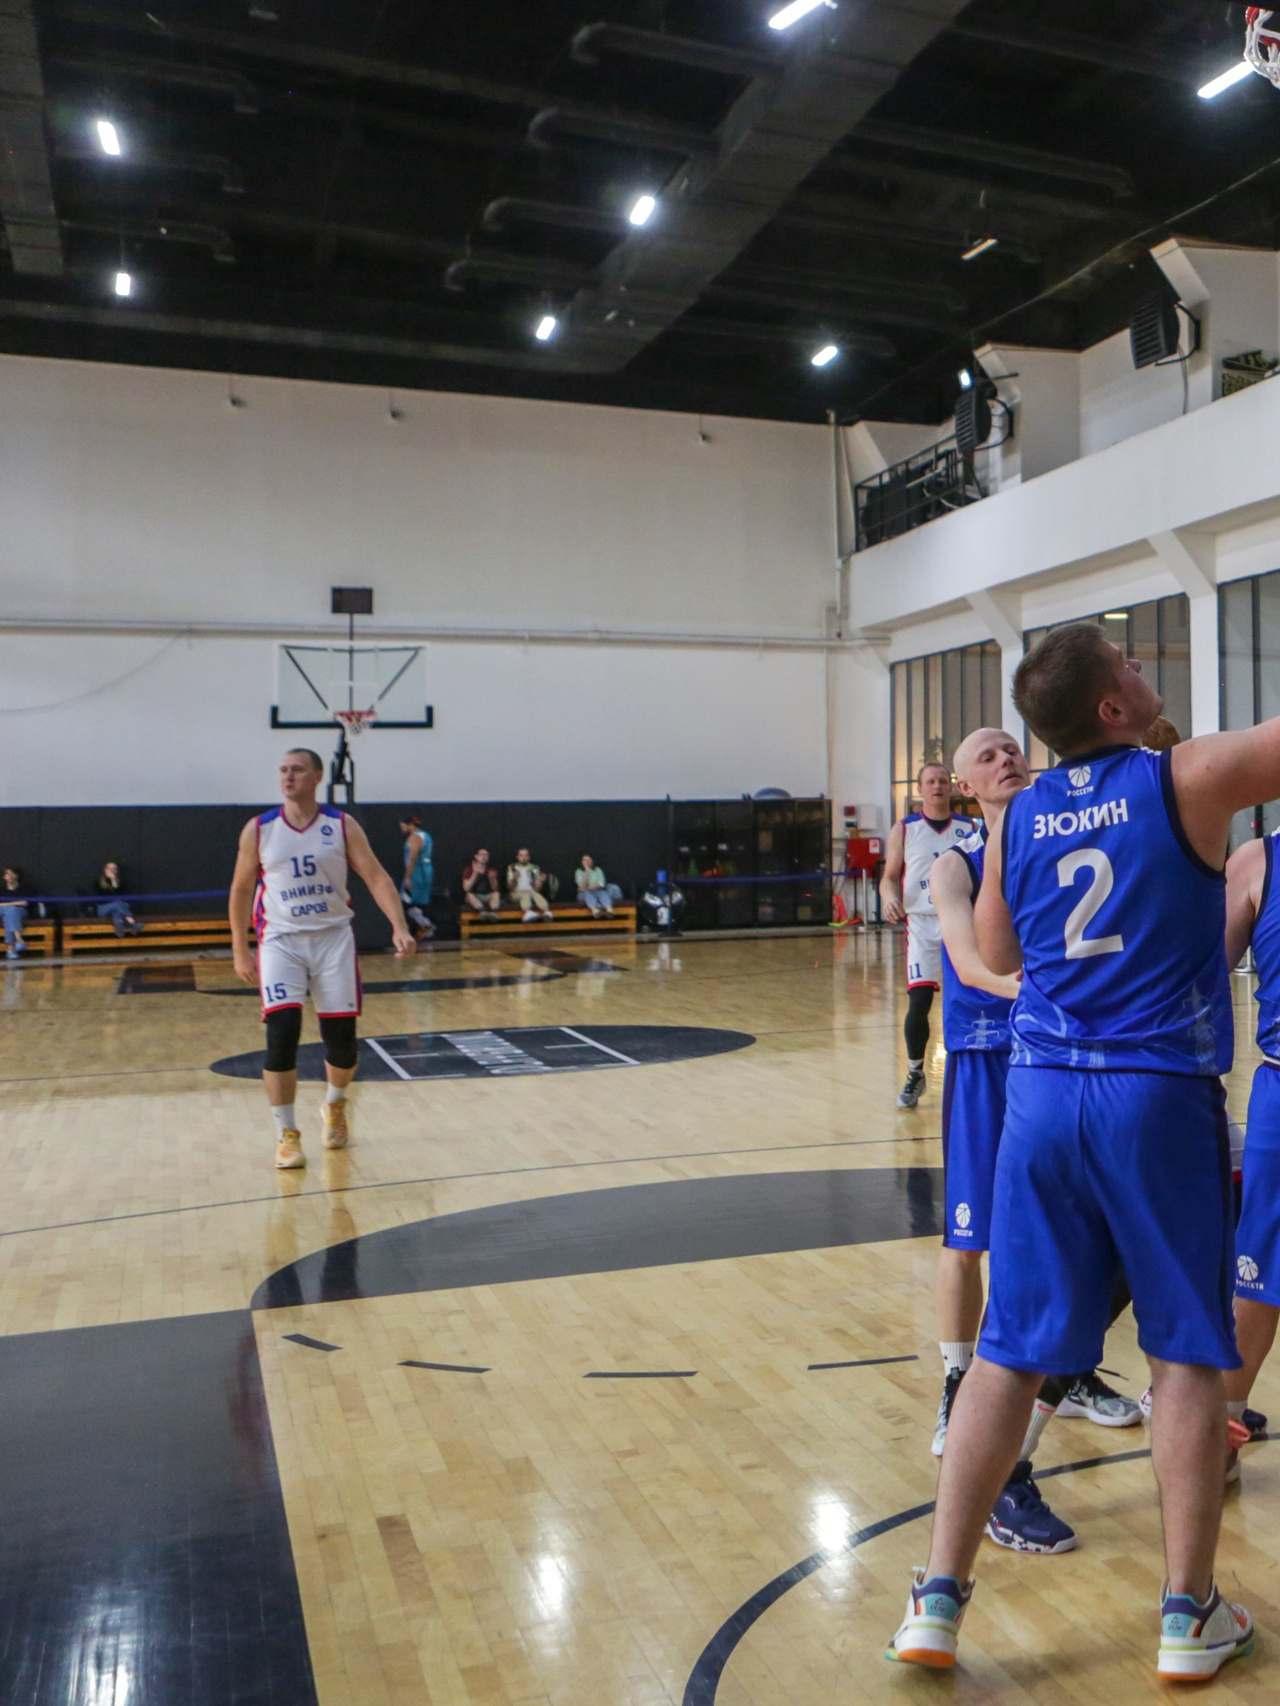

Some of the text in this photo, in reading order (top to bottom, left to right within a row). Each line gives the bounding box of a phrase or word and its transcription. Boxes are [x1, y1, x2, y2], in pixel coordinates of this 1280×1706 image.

[1067, 786, 1094, 797] РОССЕТИ
[1033, 798, 1129, 839] ЗЮКИН
[290, 854, 317, 878] 15
[291, 902, 329, 918] САРОВ
[1056, 847, 1124, 960] 2
[265, 983, 287, 1003] 15
